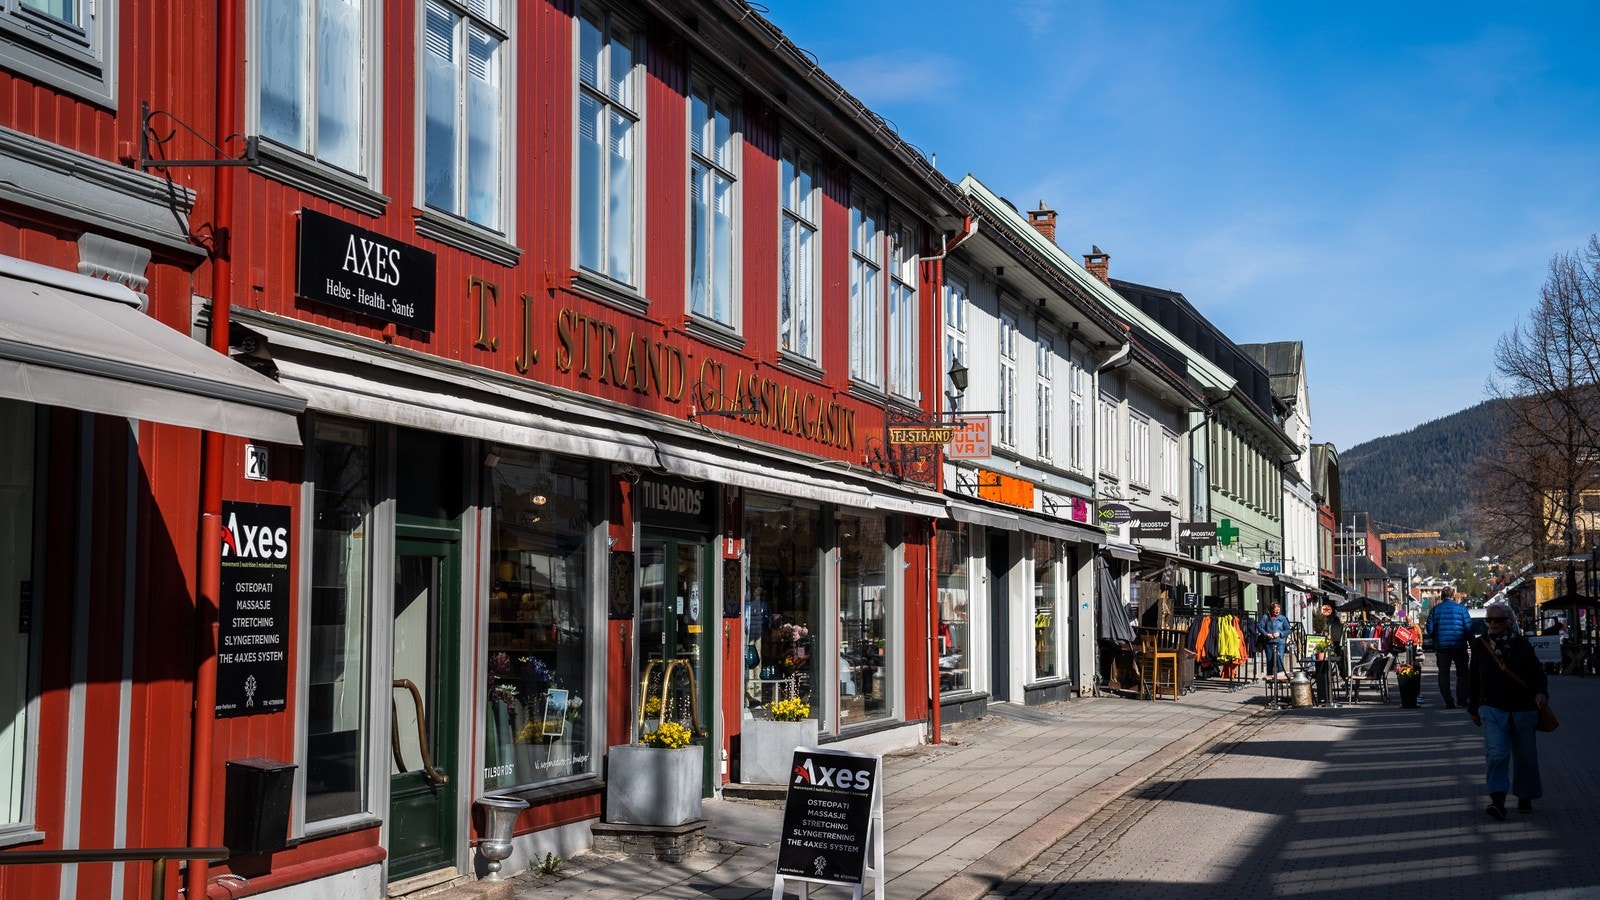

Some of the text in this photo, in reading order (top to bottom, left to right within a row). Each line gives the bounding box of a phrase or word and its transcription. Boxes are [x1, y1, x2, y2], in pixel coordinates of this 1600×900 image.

[342, 234, 401, 286] AXES
[326, 278, 351, 300] Helse
[358, 288, 386, 310] Health
[392, 298, 415, 318] Santé
[468, 275, 856, 452] T. J. STRAND GLASSMAGASIN
[955, 433, 985, 443] ULL
[955, 444, 975, 453] VA
[250, 451, 266, 475] 76
[222, 512, 288, 559] Axes
[235, 582, 273, 593] OSTEOPATI
[236, 600, 271, 610] MASSASJE
[232, 617, 273, 628] STRETCHING
[224, 634, 280, 646] SLYNGETRENING
[219, 651, 283, 664] THE 4AXES SYSTEM
[794, 758, 871, 790] Axes
[807, 799, 850, 810] OSTEOPATI
[807, 809, 846, 820] MASSASJE
[802, 819, 849, 830] STRETCHING
[793, 828, 855, 841] SLYNGETRENING
[787, 838, 859, 853] THE 4AXES SYSTEM
